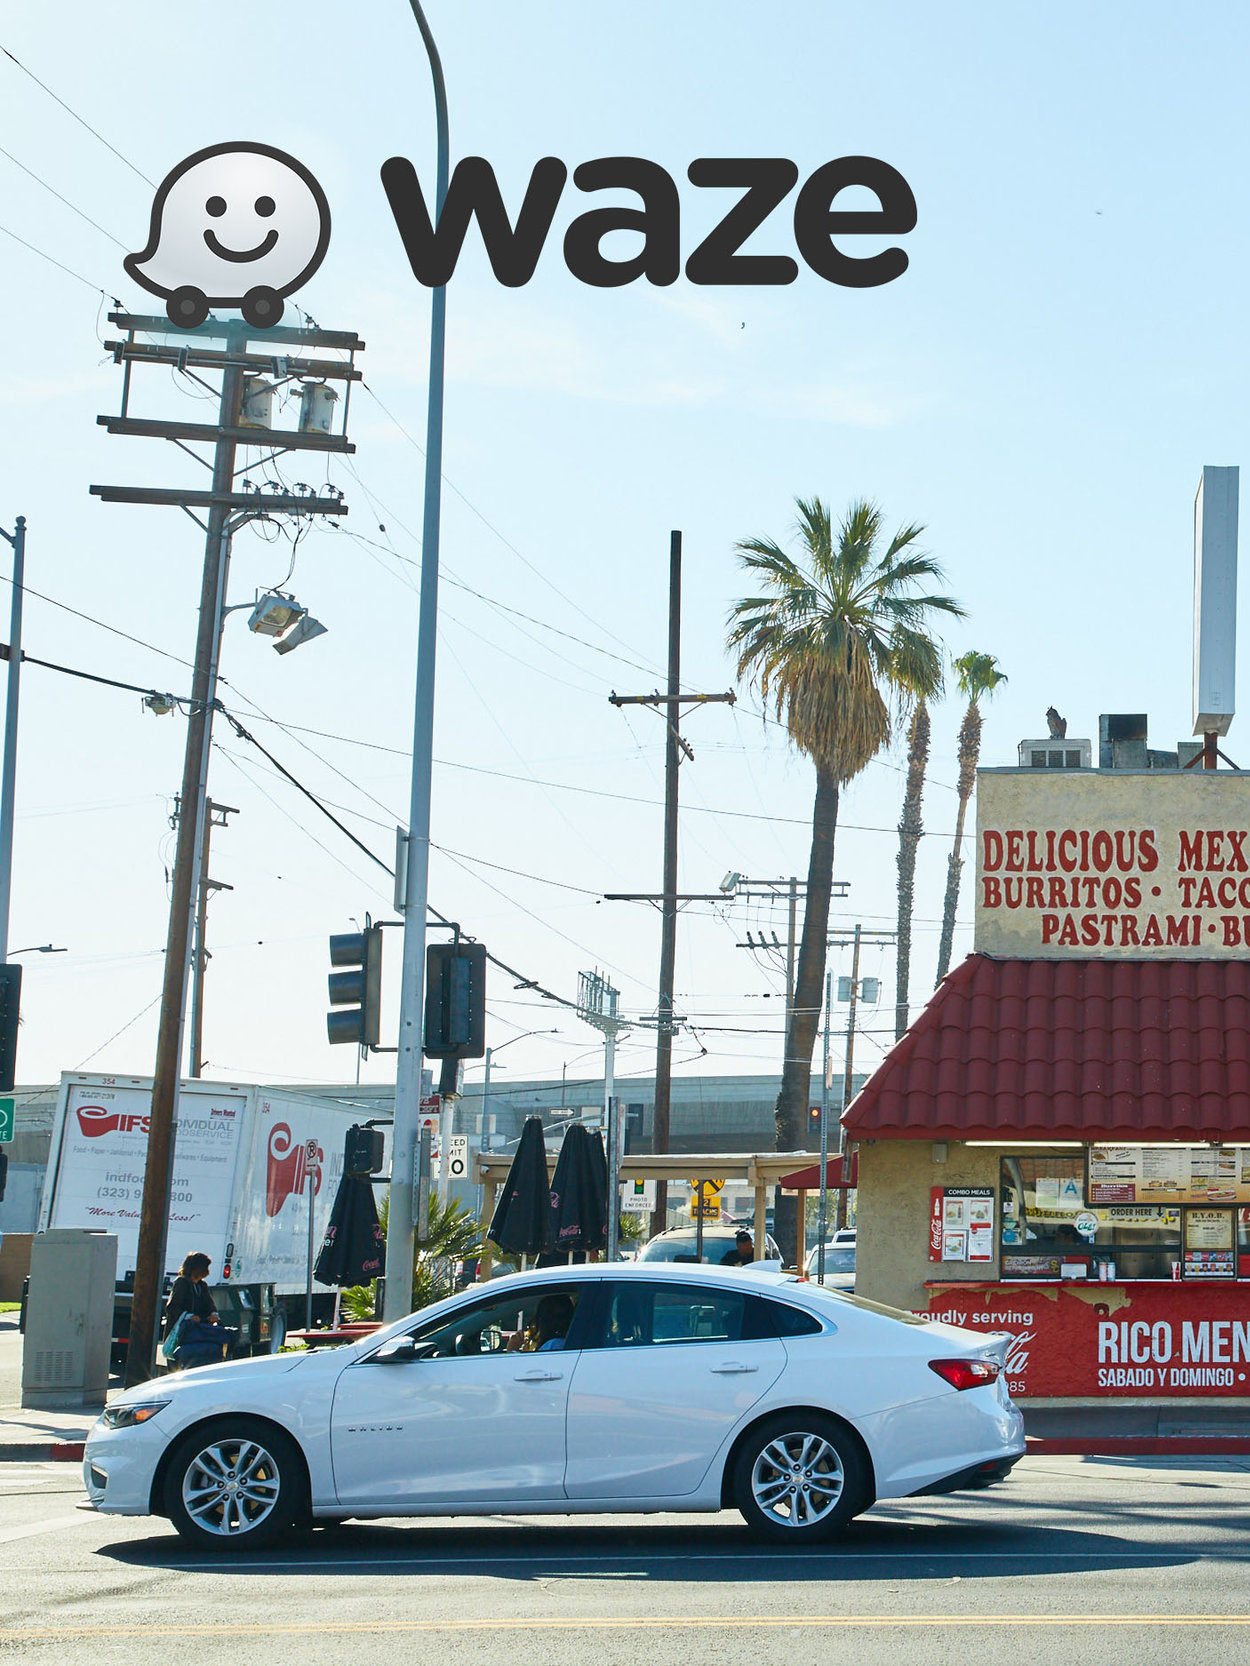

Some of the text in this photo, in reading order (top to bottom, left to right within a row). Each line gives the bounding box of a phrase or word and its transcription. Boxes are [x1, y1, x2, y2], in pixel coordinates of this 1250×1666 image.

[982, 829, 1159, 873] DELICIOUS
[981, 876, 1142, 909] BURRITOS
[1041, 914, 1201, 947] PASTRAMI
[97, 1186, 130, 1200] (323)
[1064, 1181, 1078, 1195] A
[703, 1199, 709, 1207] 2
[1110, 1208, 1152, 1216] ORDER HERE
[972, 1309, 1033, 1326] serving
[1098, 1320, 1172, 1363] RICO
[1098, 1368, 1154, 1387] SABADO
[1158, 1368, 1166, 1386] Y
[1170, 1368, 1234, 1387] DOMINGO
